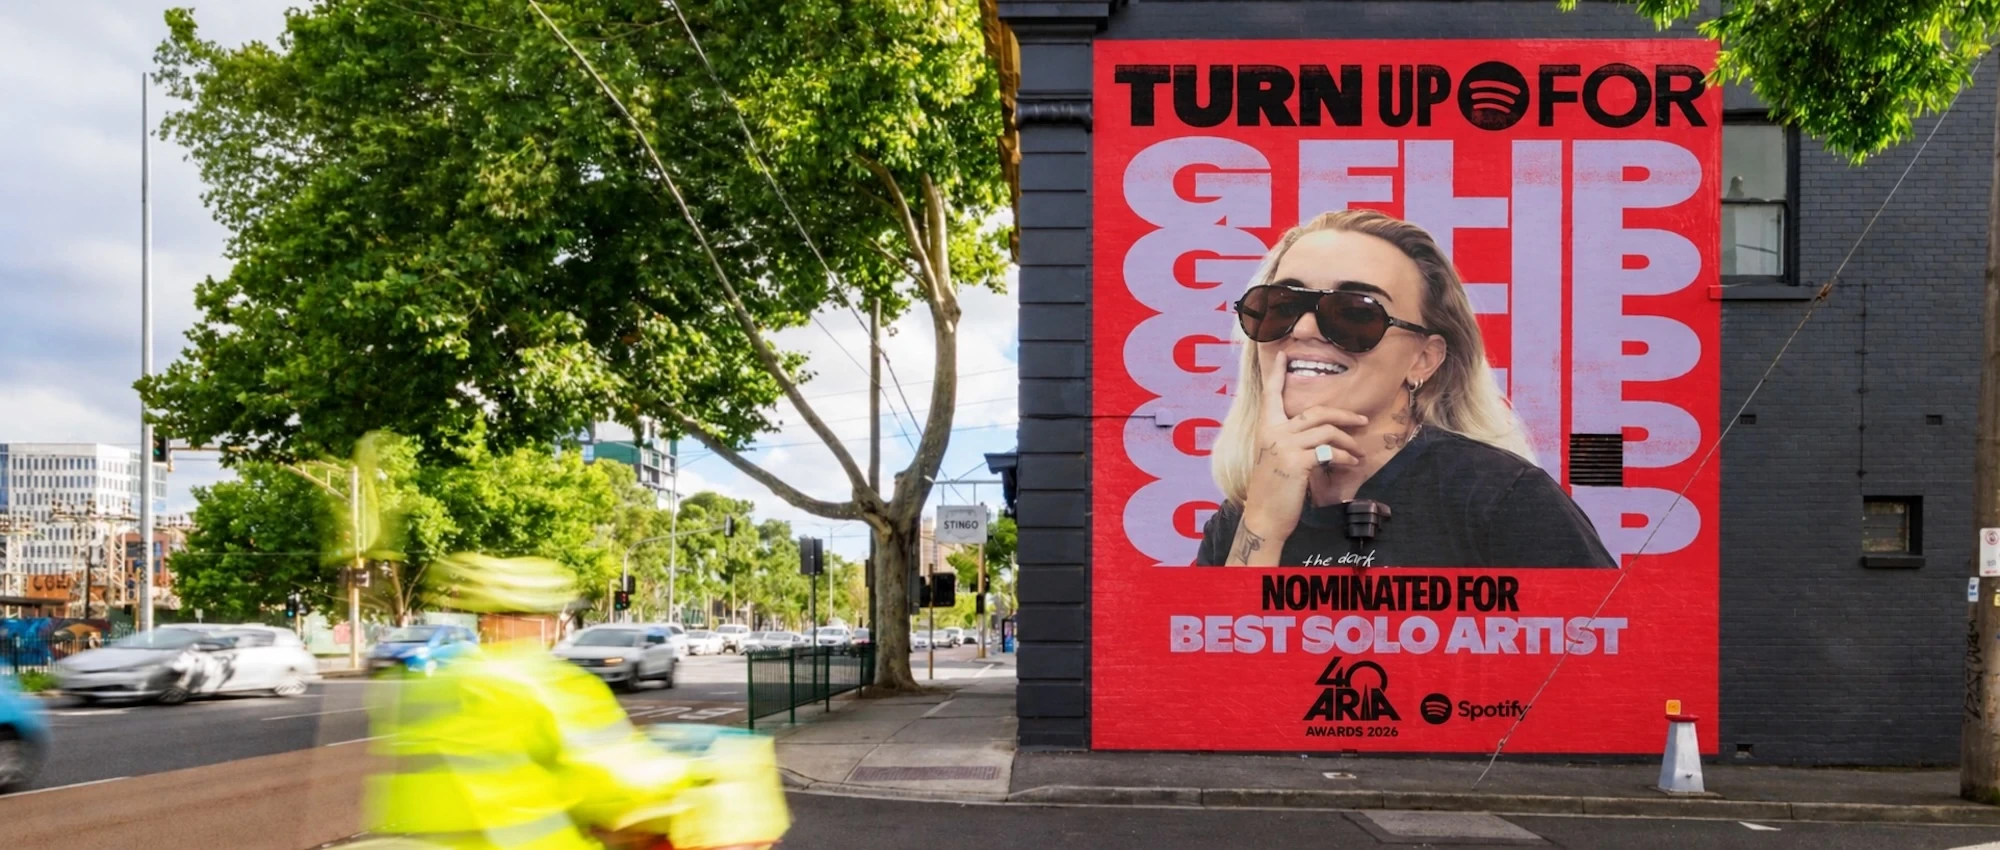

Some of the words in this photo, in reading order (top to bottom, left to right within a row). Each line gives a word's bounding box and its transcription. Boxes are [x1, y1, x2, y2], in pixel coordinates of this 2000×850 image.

[1114, 64, 1363, 127] TURN
[1378, 64, 1452, 128] UP
[1538, 63, 1708, 128] FOR
[1123, 136, 1272, 229] G
[943, 520, 979, 530] STINGO
[1302, 553, 1333, 567] the
[1337, 549, 1376, 567] dark
[1261, 575, 1452, 612] NOMINATED
[1458, 576, 1520, 612] FOR
[1170, 615, 1296, 654] BEST
[1301, 616, 1440, 655] SOLO
[1444, 617, 1628, 655] ARTIST
[1314, 656, 1388, 693] 40
[1302, 684, 1402, 721] ARIA
[1458, 701, 1532, 721] Spotify
[1305, 726, 1364, 737] AWARDS
[1367, 726, 1399, 737] 2026
